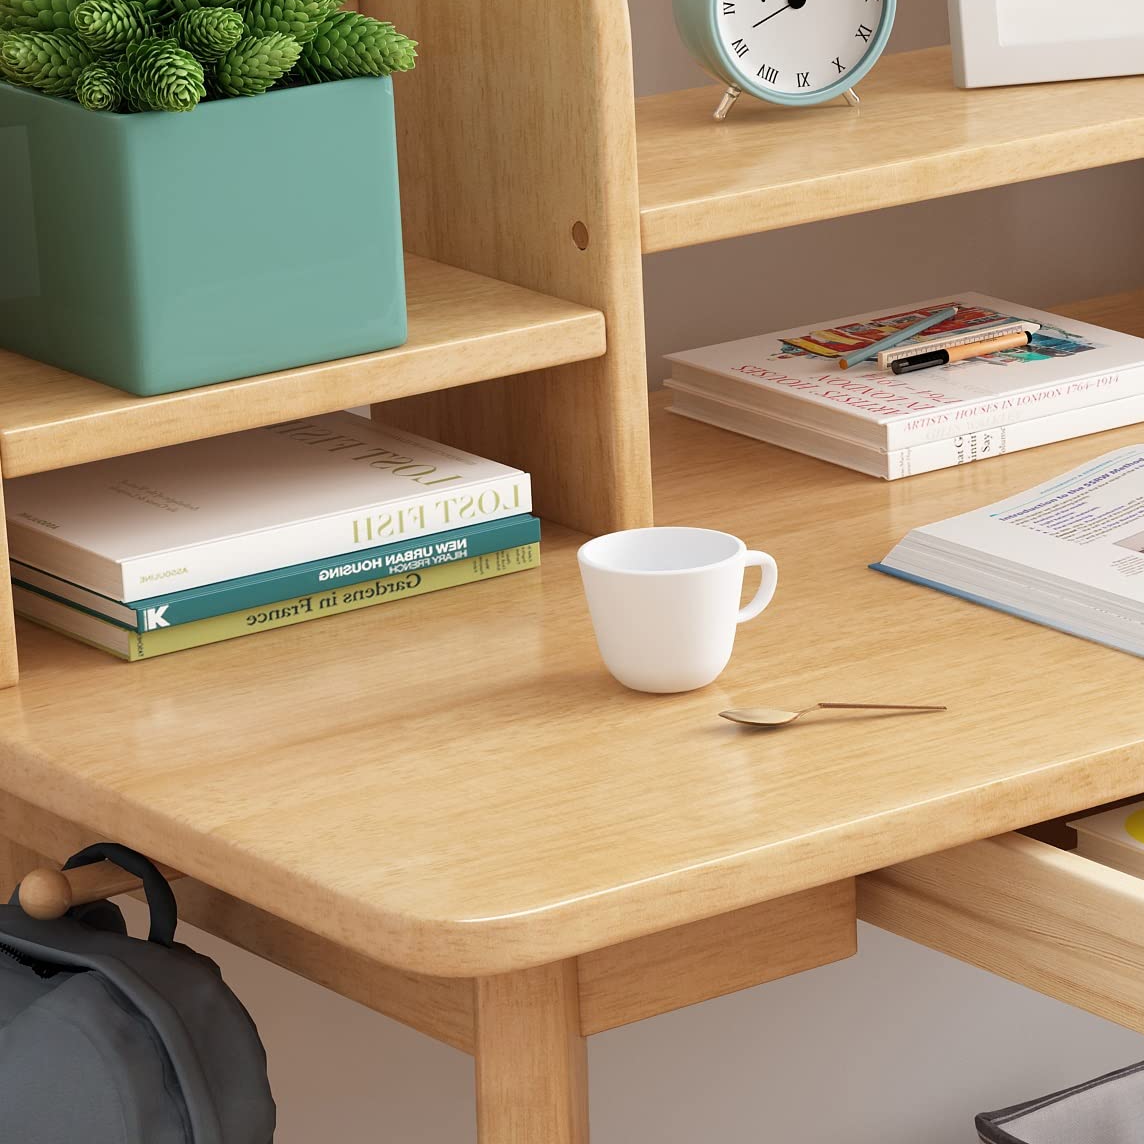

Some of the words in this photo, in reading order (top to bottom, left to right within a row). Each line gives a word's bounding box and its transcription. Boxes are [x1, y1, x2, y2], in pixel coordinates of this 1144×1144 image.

[730, 364, 819, 390] HOUSES
[812, 374, 909, 403] LONDON
[954, 404, 1000, 421] HOUSES
[1001, 400, 1015, 410] IN
[1016, 387, 1063, 407] LONDON
[982, 433, 993, 454] Say
[1057, 492, 1069, 502] to
[1068, 485, 1085, 497] the
